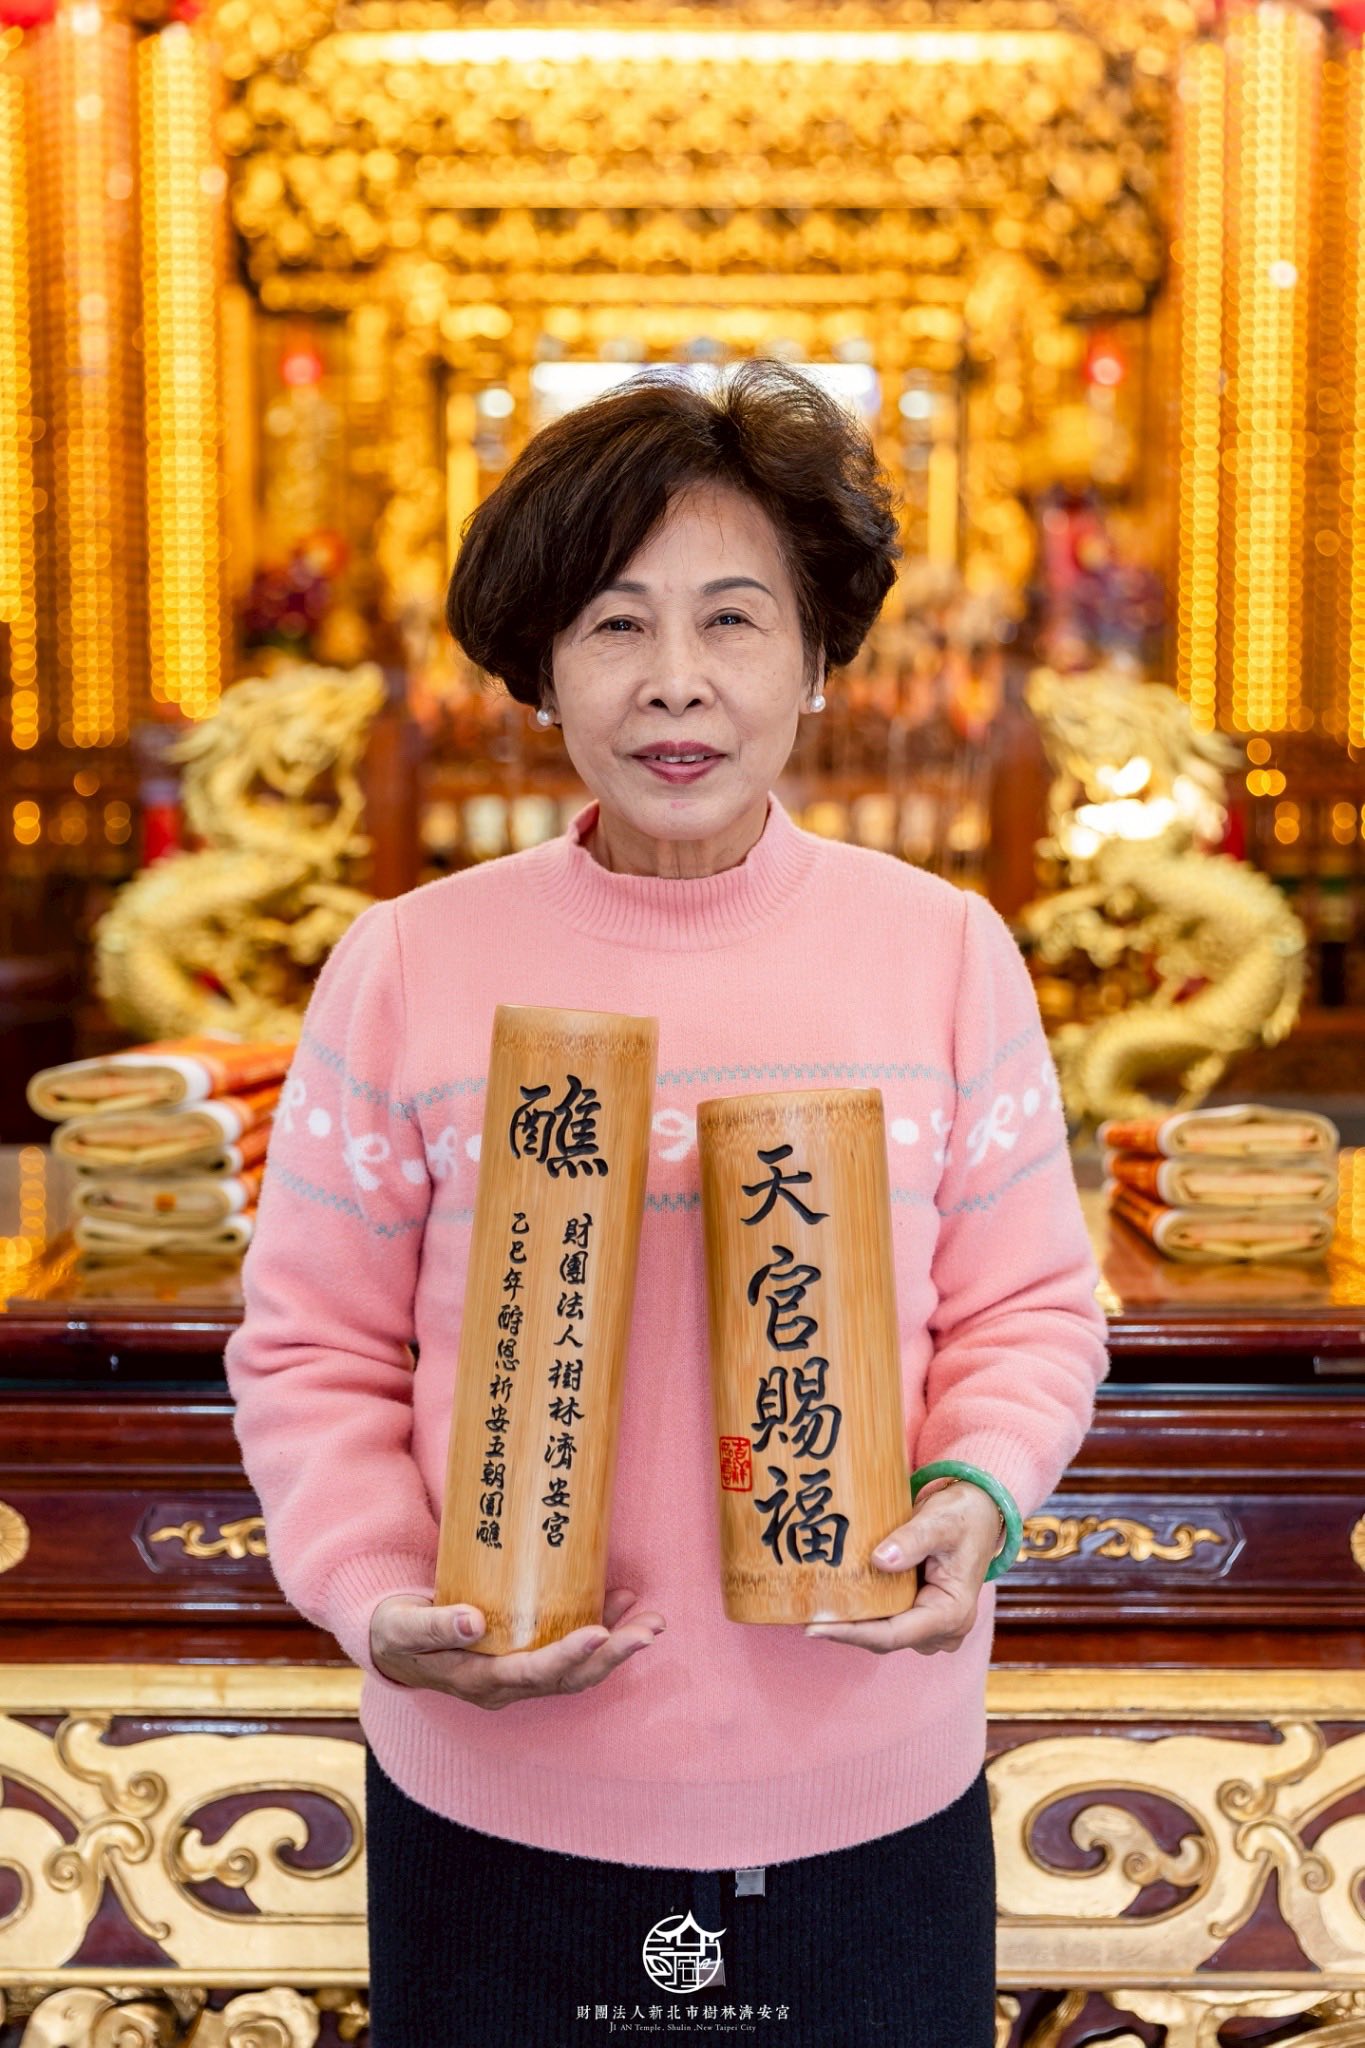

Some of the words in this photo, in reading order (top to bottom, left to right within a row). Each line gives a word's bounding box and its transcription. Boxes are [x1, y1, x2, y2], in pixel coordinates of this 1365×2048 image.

[509, 1074, 609, 1179] 醮
[541, 1212, 593, 1548] 財團法人樹林濟安宮
[740, 1144, 850, 1567] 天官賜福
